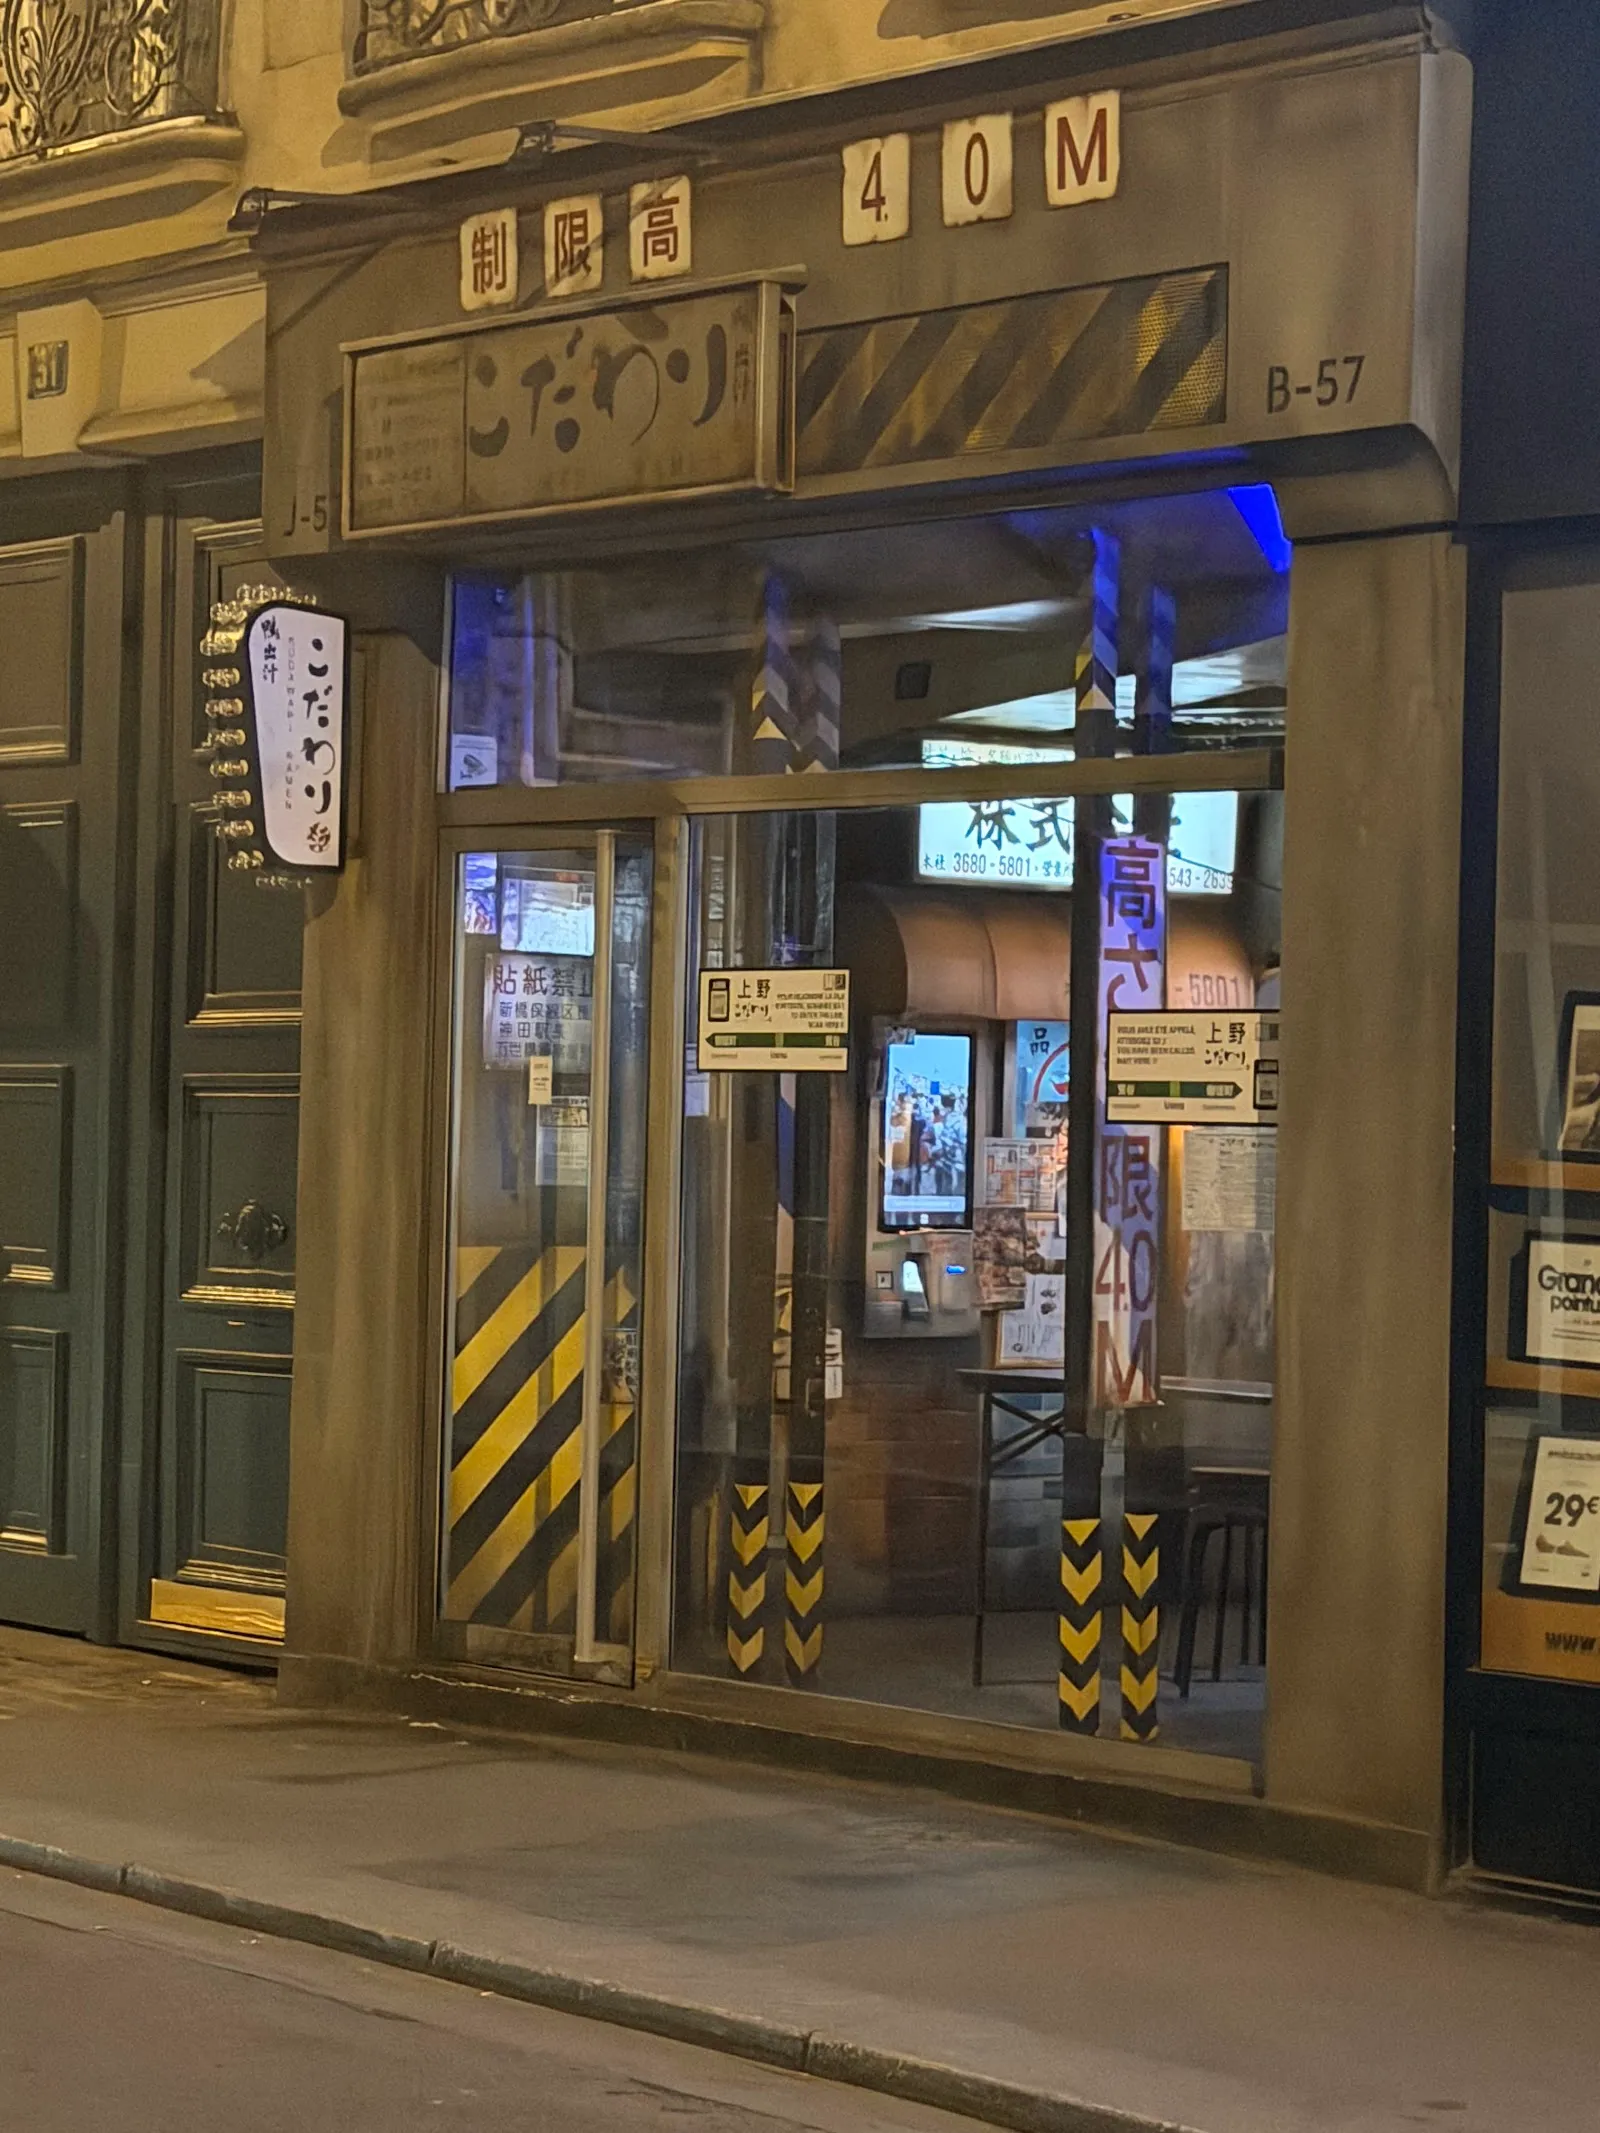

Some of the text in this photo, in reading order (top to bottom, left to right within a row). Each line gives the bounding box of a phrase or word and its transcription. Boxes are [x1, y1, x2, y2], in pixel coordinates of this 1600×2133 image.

[1265, 355, 1366, 414] B-57
[283, 494, 327, 537] J-5
[953, 853, 1031, 878] 3680-5801
[736, 977, 772, 1000] 上野
[1204, 1020, 1247, 1045] 上野
